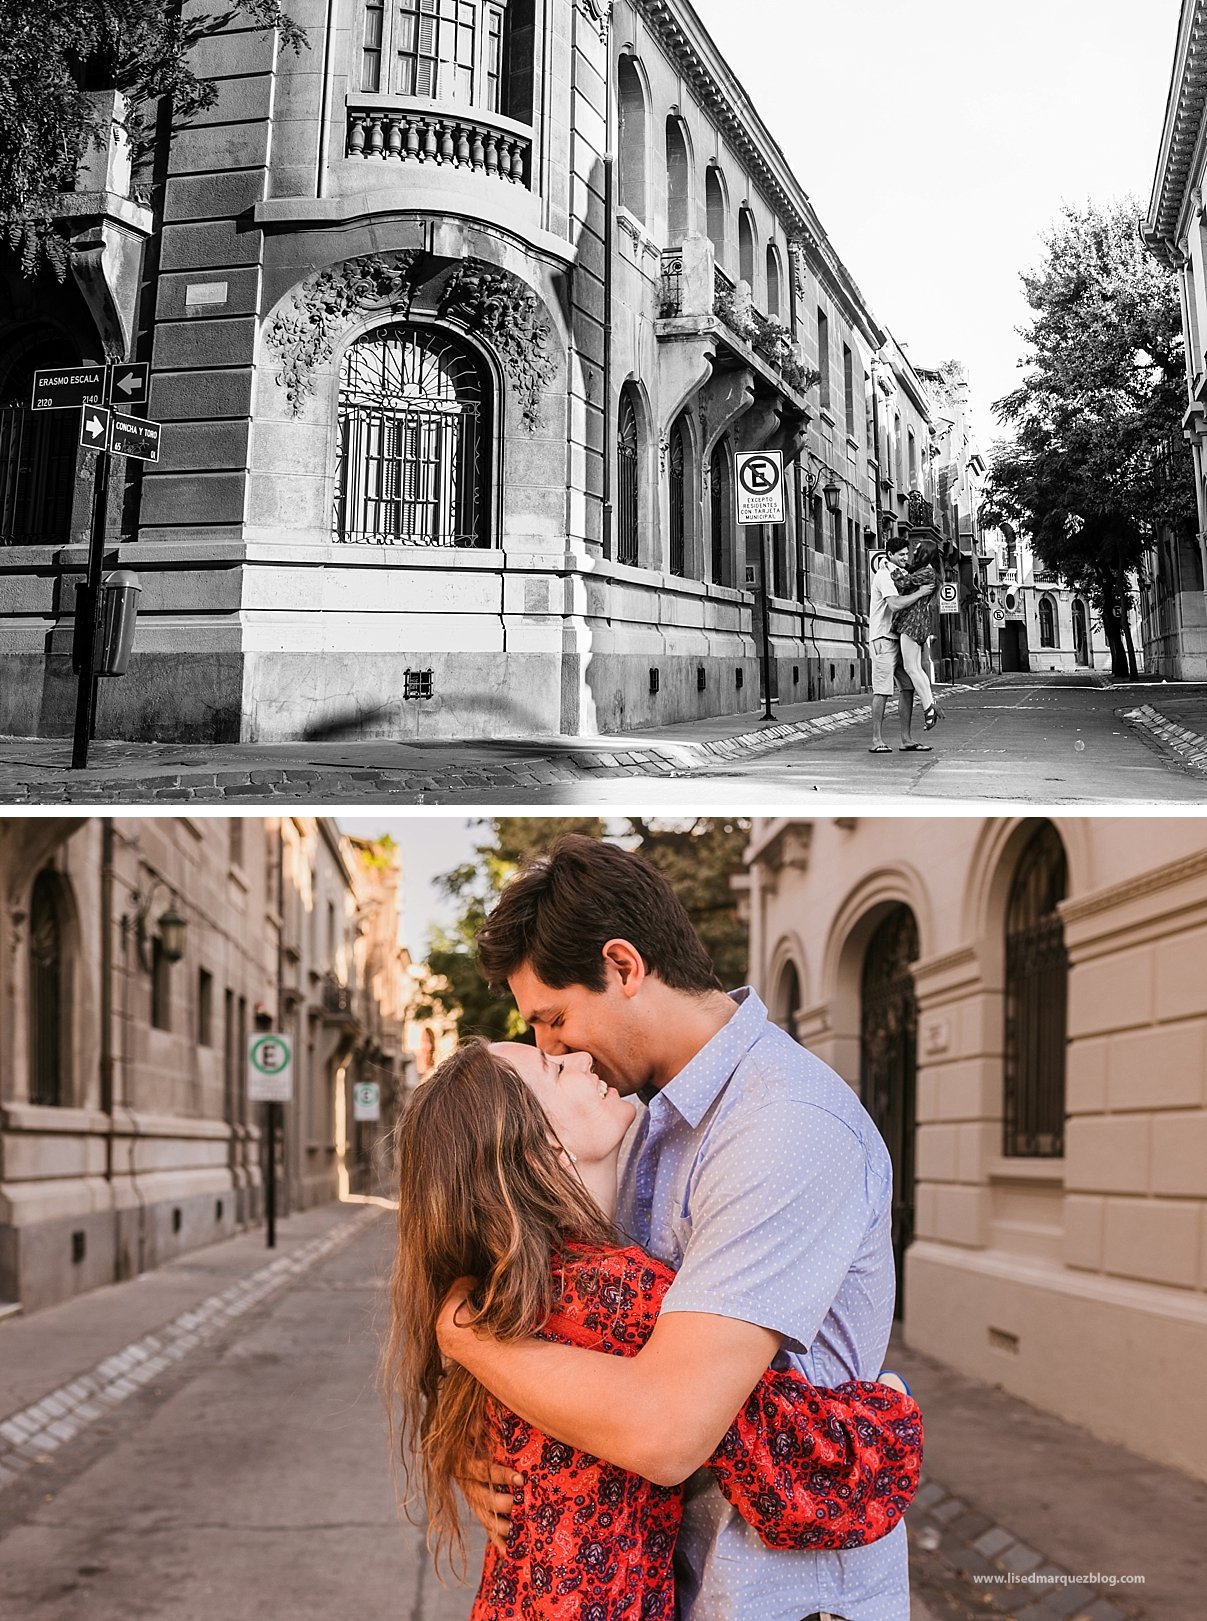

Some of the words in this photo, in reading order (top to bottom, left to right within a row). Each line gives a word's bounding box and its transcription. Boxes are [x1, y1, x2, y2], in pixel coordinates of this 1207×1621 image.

[39, 376, 69, 387] ERASMO
[70, 374, 100, 385] ESCALA
[37, 398, 53, 407] 2120
[82, 394, 99, 404] 2140
[116, 421, 138, 434] CONCHA
[138, 426, 144, 436] Y
[144, 428, 158, 440] TORO
[752, 463, 768, 488] E
[945, 587, 952, 598] E
[263, 1044, 277, 1067] E
